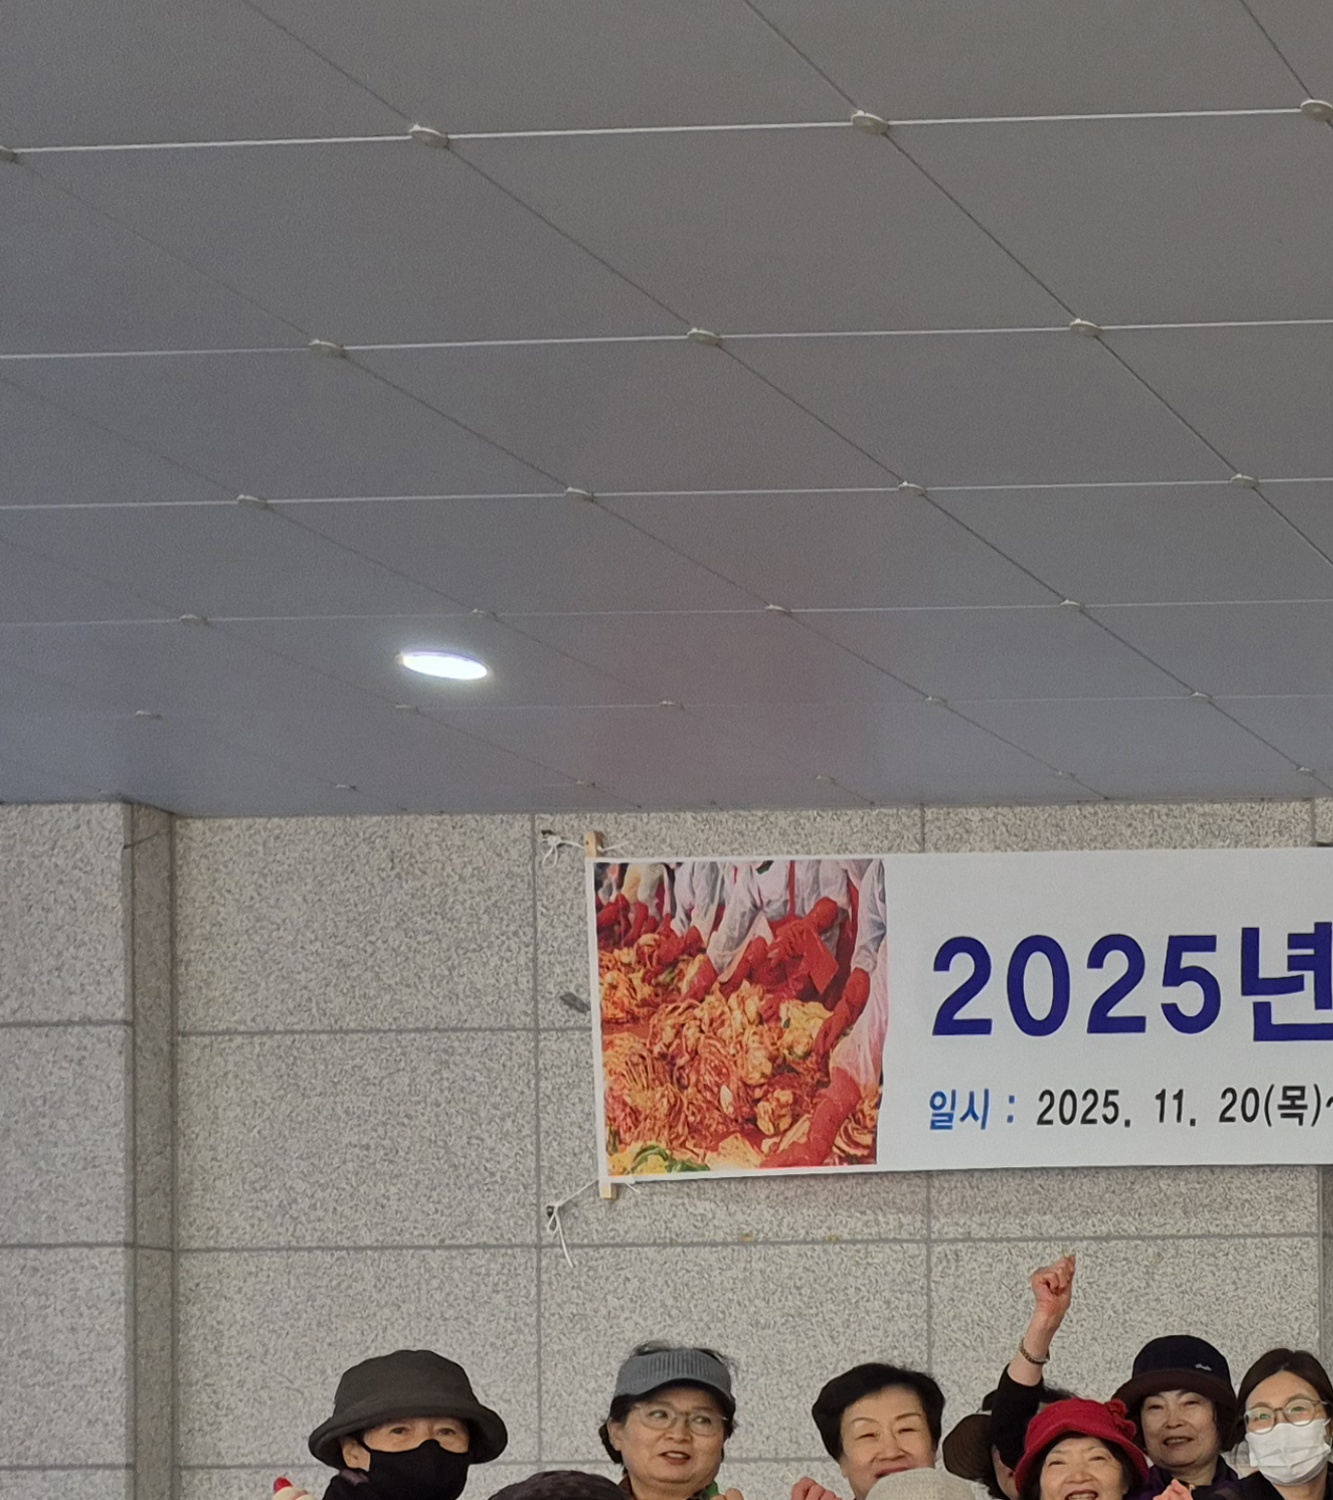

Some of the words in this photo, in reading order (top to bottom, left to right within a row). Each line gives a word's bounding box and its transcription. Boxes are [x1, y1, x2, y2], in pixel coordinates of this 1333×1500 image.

[929, 1088, 990, 1131] 일시
[1036, 1087, 1131, 1129] 2025.
[1154, 1088, 1197, 1127] 11.
